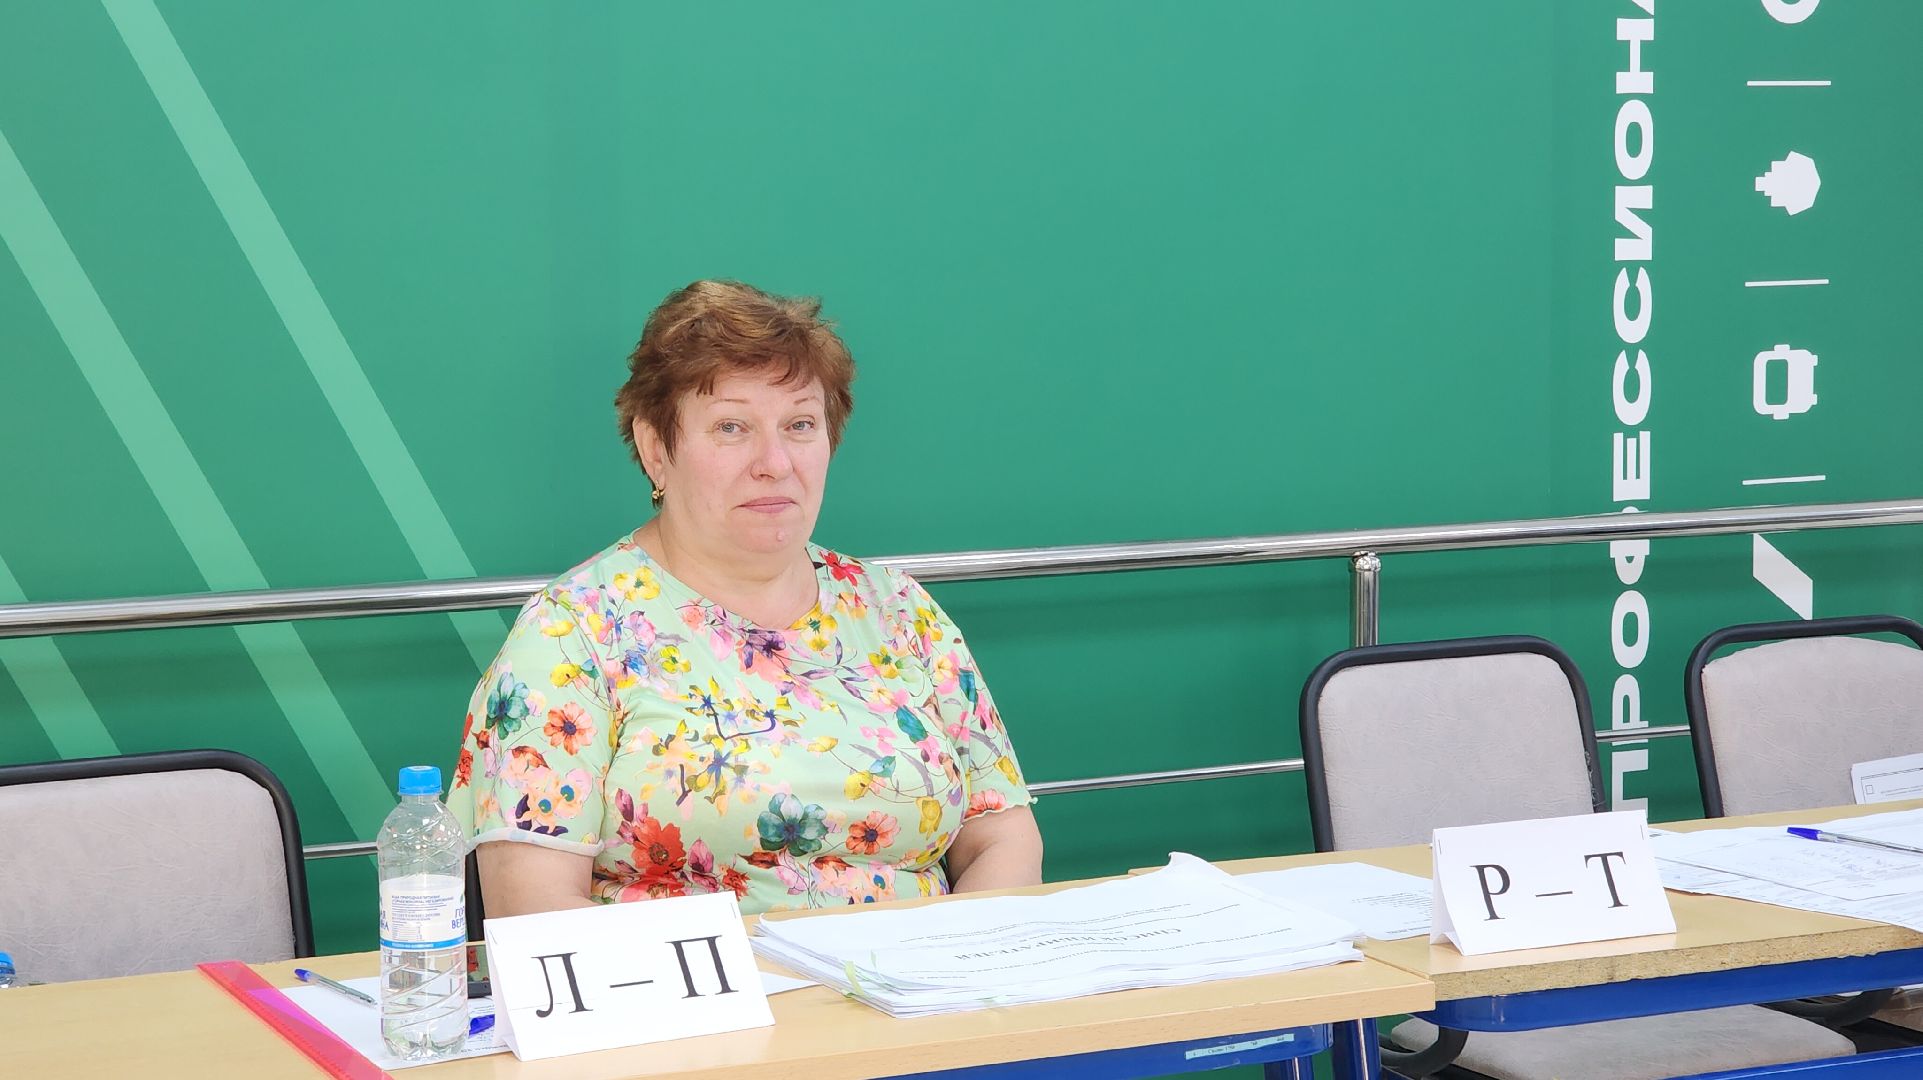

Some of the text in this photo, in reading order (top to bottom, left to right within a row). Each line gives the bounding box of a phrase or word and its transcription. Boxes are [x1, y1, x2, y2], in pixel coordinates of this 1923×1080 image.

[1610, 0, 1654, 819] ПРОФЕССИОН
[1470, 864, 1511, 921] Р
[1584, 851, 1629, 908] Т
[531, 952, 593, 1018] Л
[665, 935, 739, 999] П
